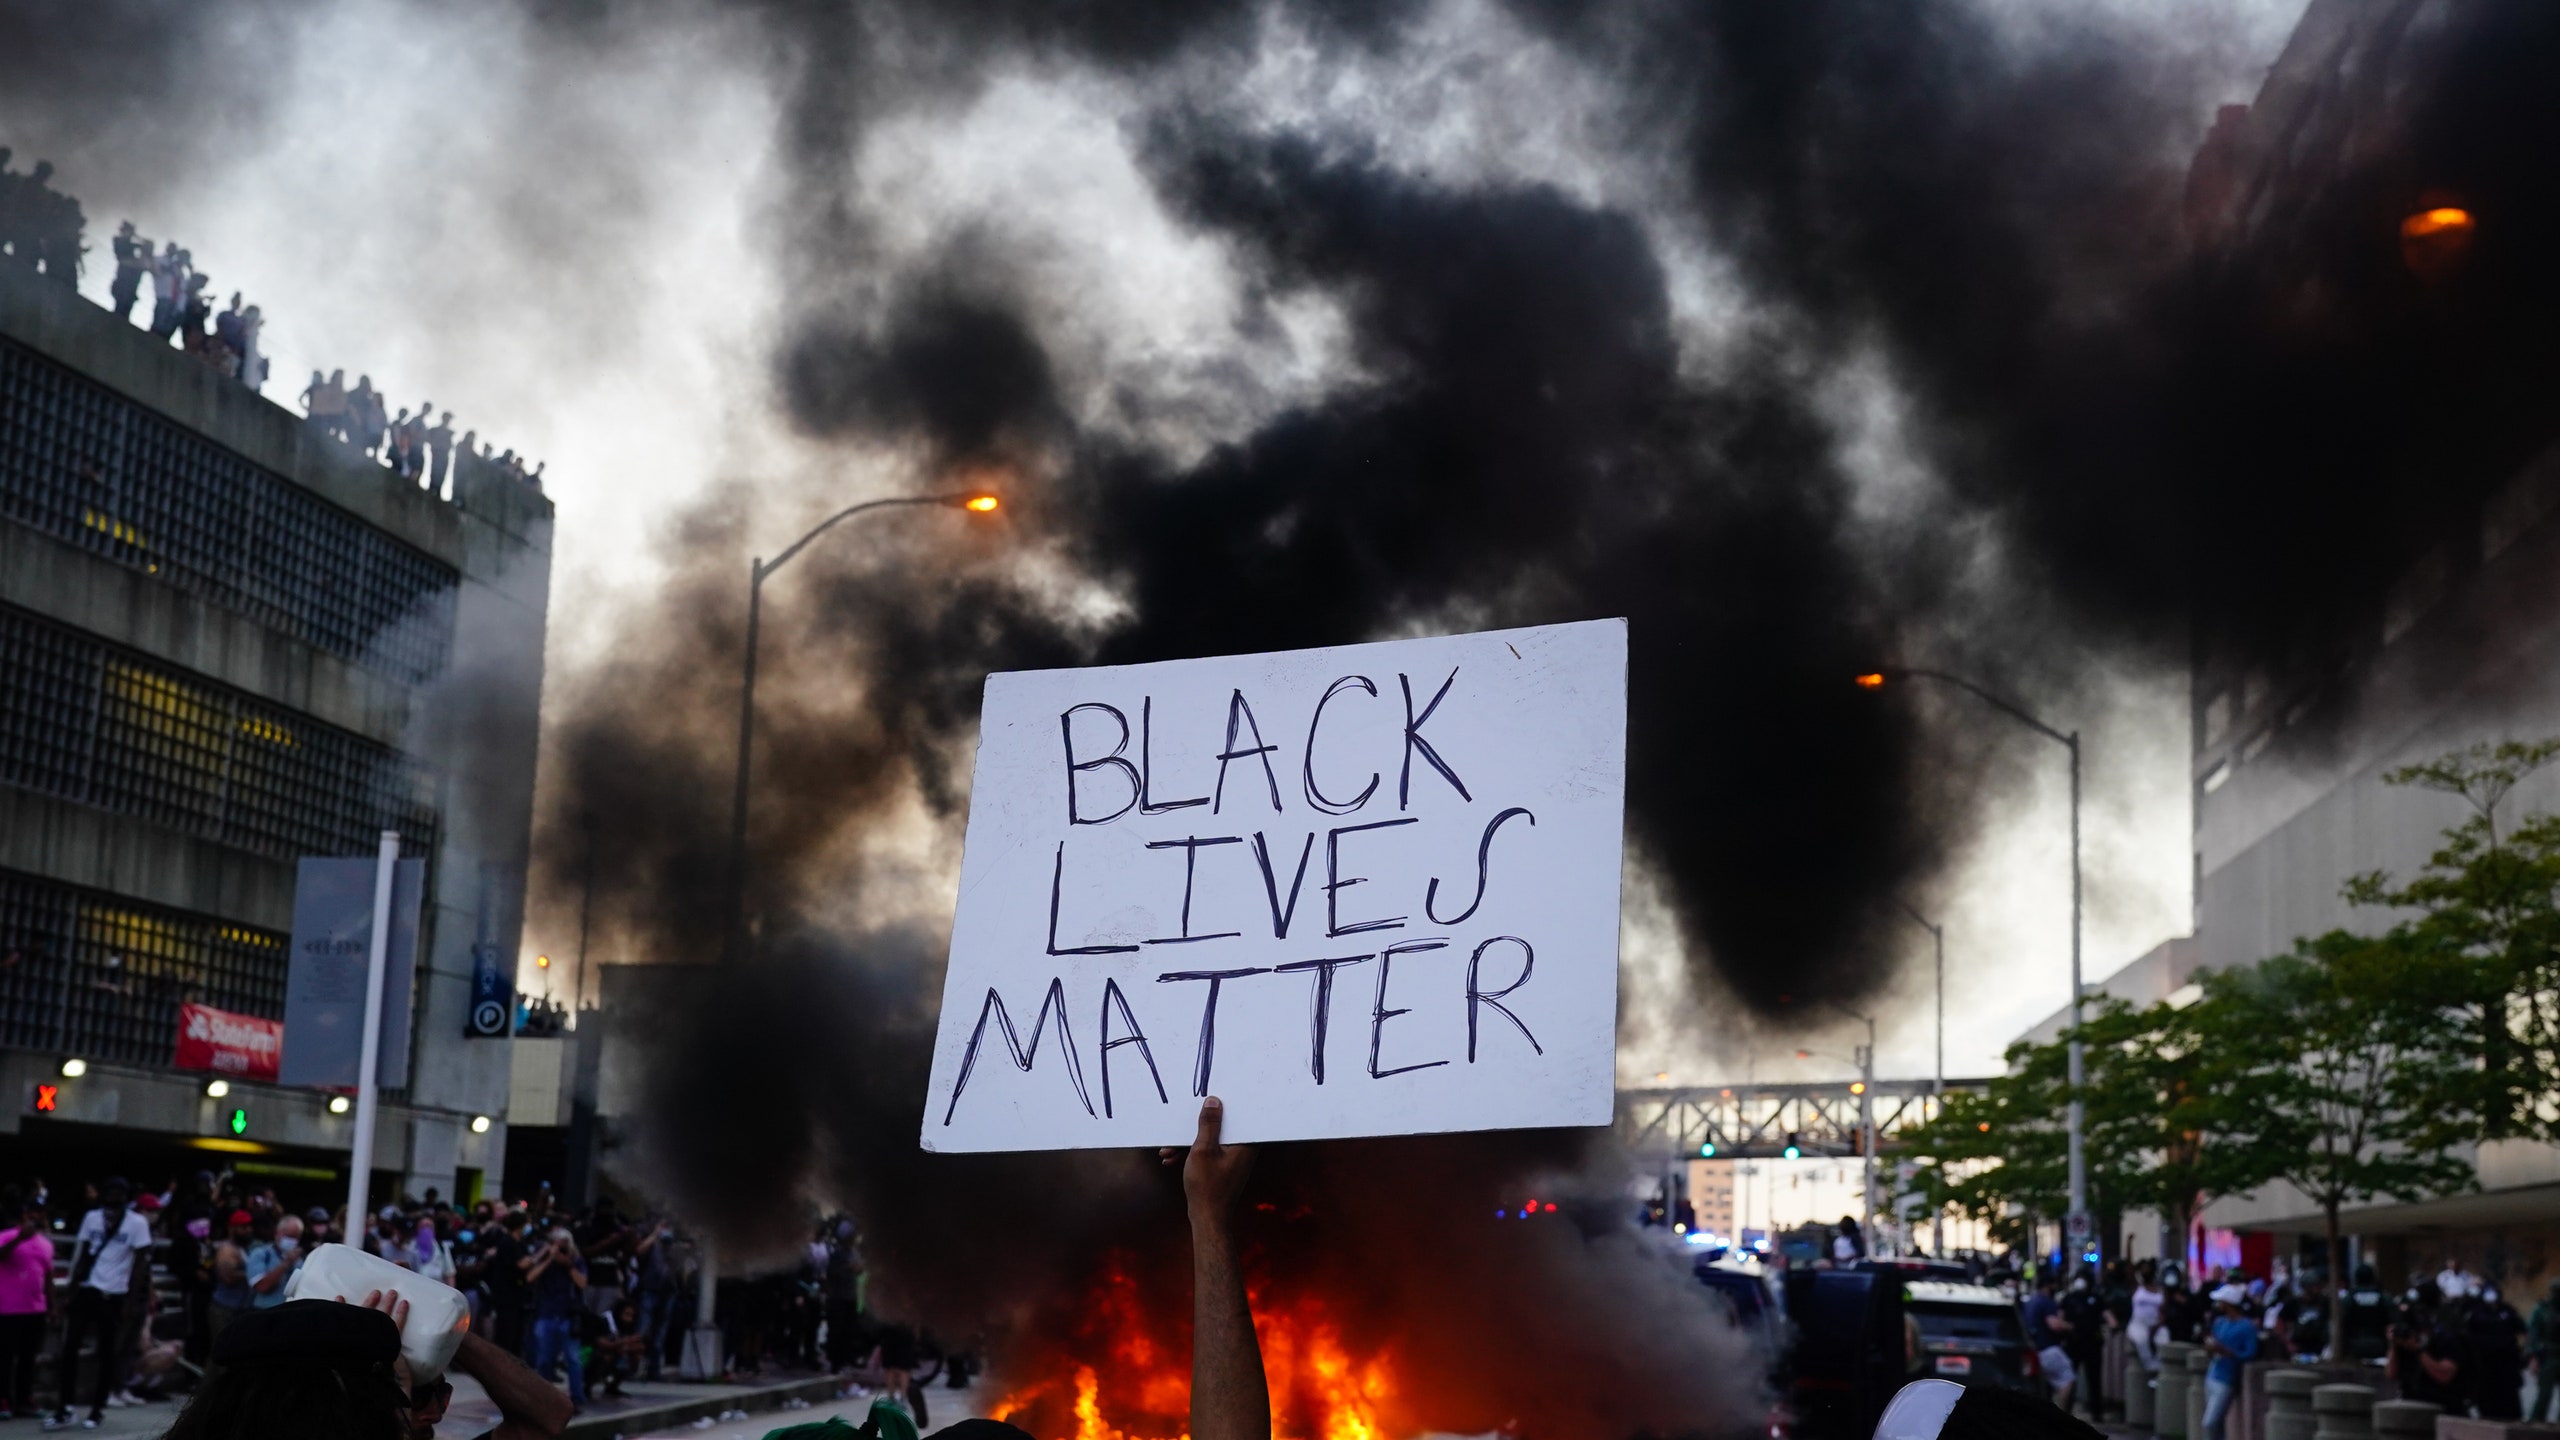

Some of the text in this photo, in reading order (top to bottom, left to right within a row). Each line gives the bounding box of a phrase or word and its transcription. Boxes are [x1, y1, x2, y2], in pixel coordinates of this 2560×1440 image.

[1060, 666, 1473, 826] BLACK
[1046, 808, 1536, 957] LIVES
[944, 936, 1544, 1127] MATTER
